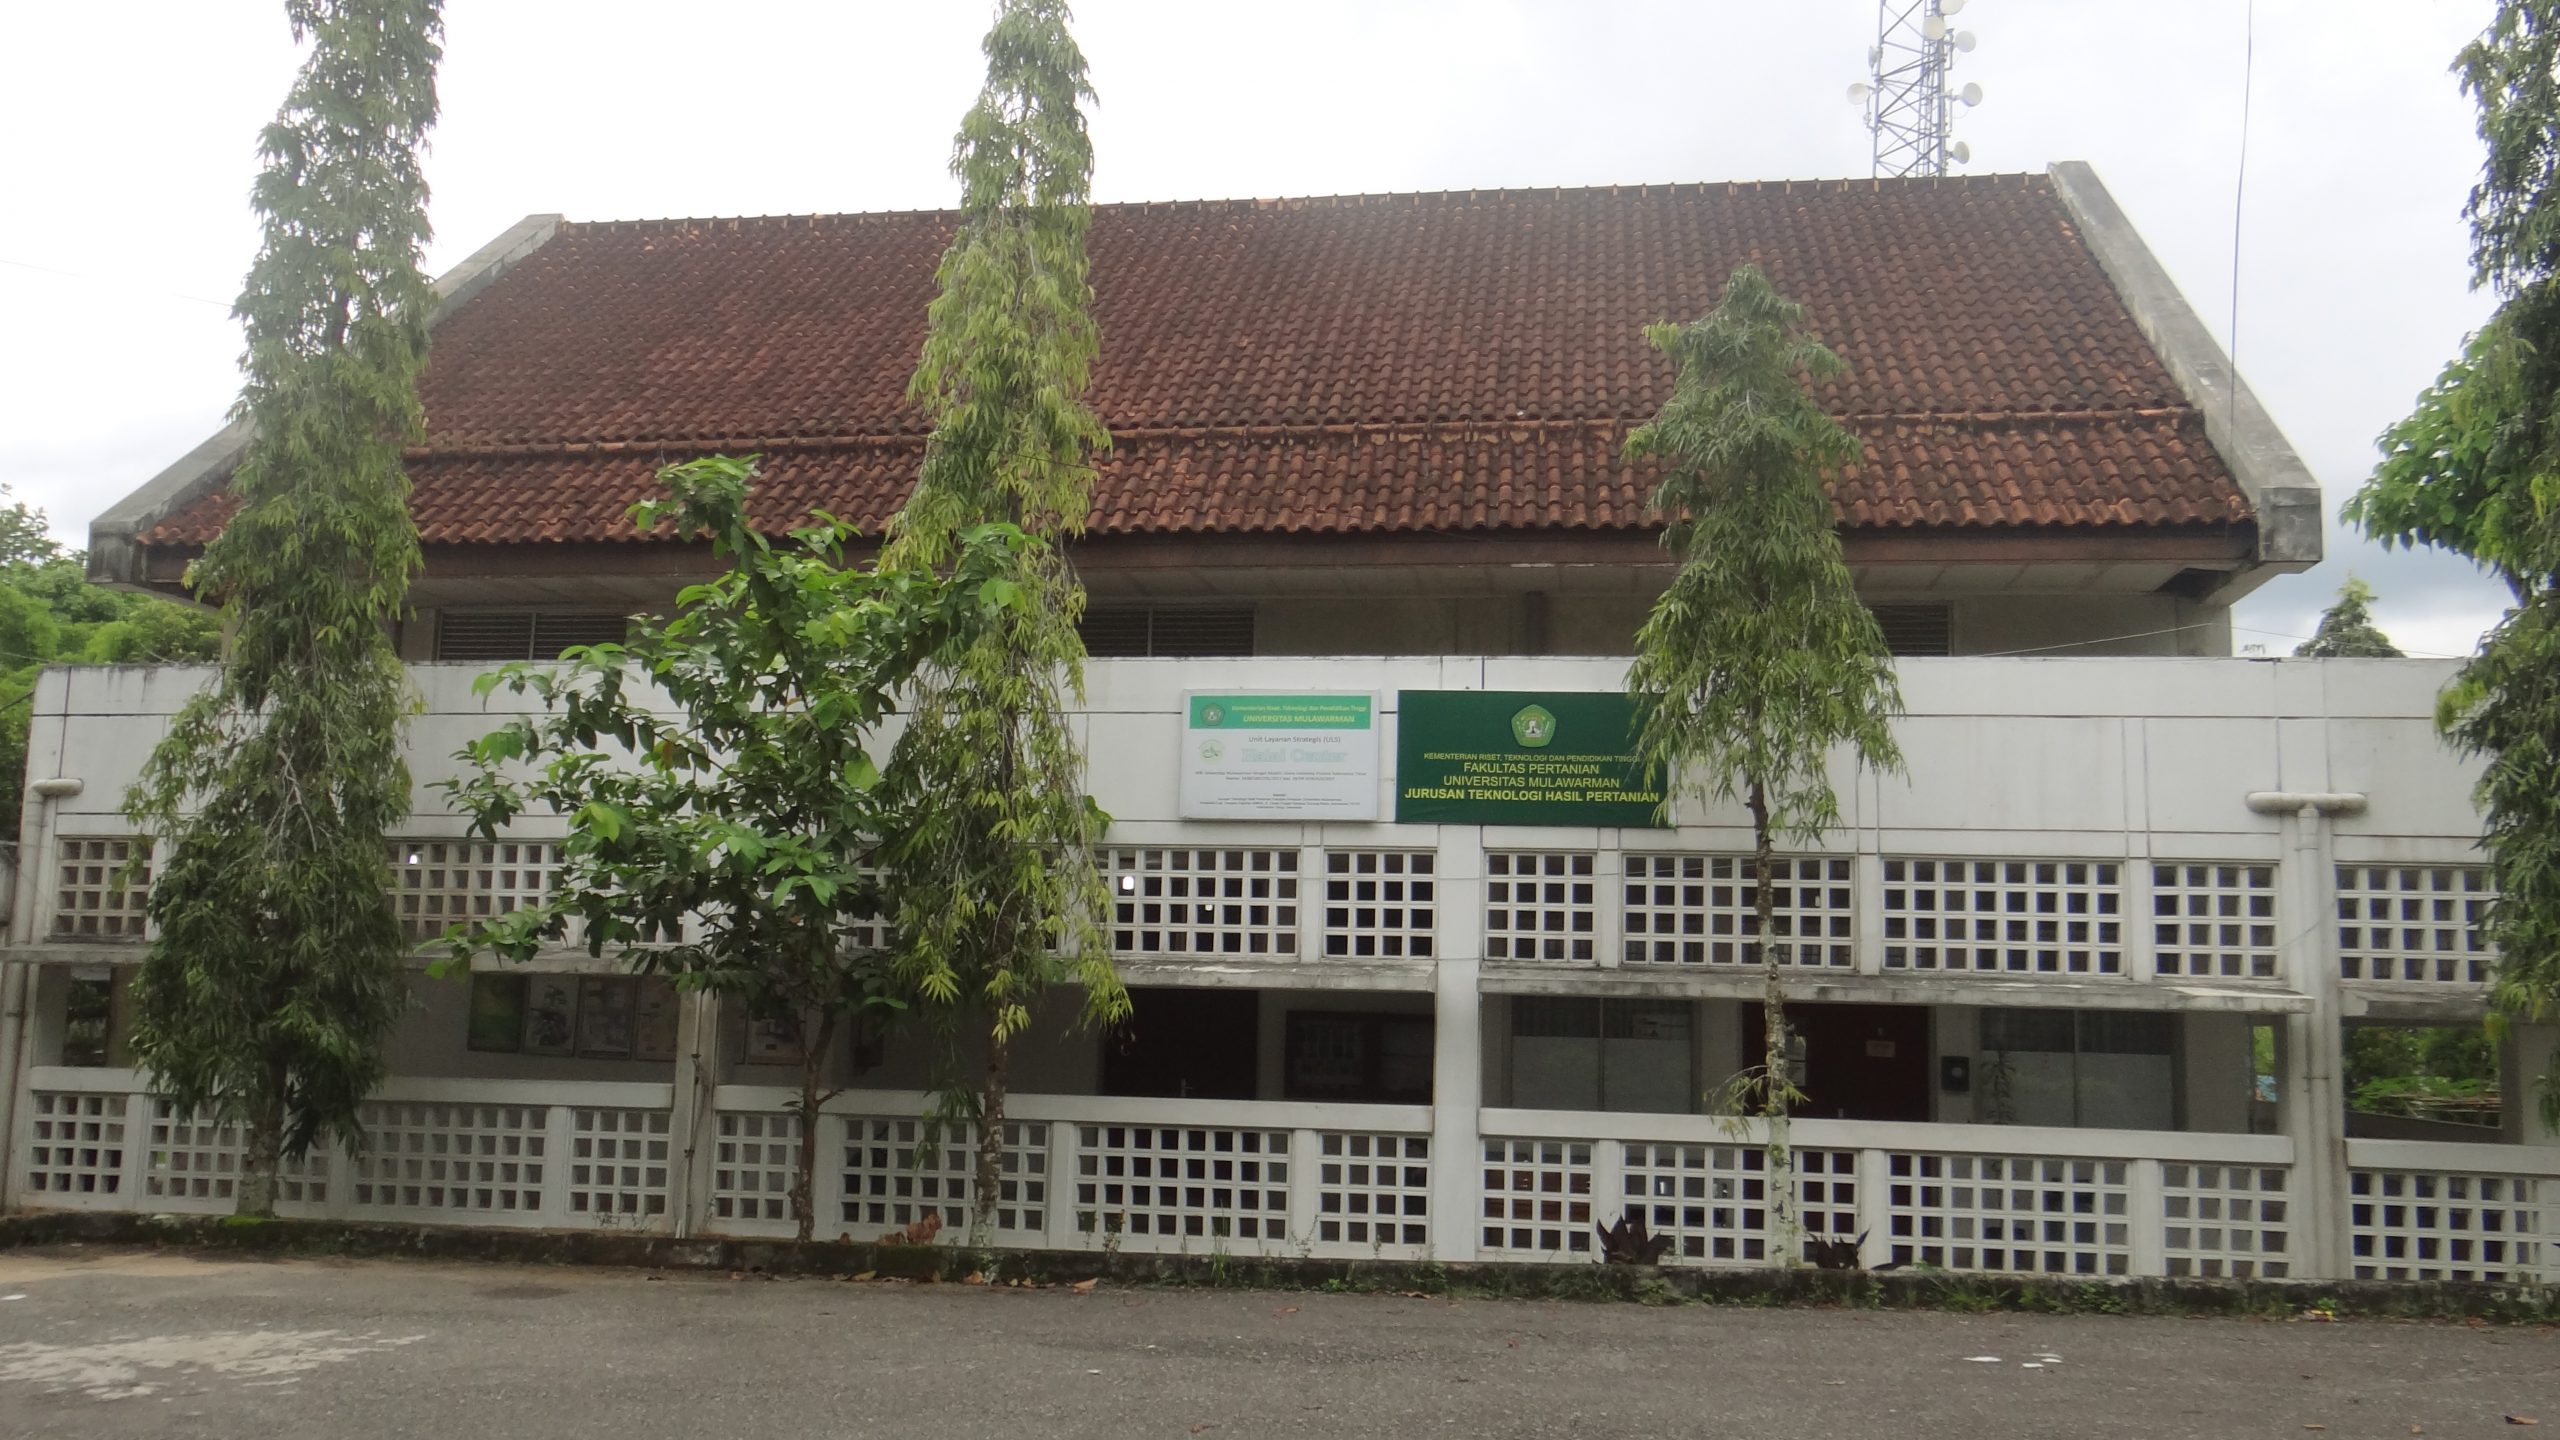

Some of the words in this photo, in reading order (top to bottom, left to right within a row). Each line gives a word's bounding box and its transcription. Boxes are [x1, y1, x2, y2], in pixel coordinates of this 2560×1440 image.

[1243, 714, 1292, 722] UNIVERSITAS
[1294, 714, 1355, 723] MULAWARMAN
[1264, 736, 1291, 745] Layanan
[1293, 736, 1322, 745] Strategis
[1323, 736, 1341, 744] (ULS)
[1479, 753, 1502, 761] RISET,
[1464, 762, 1525, 773] FAKULTAS
[1528, 763, 1599, 774] PERTANIAN
[1443, 775, 1525, 787] UNIVERSITAS
[1528, 777, 1620, 788] MULAWARMAN
[1404, 788, 1464, 799] JURUSAN
[1468, 789, 1542, 801] TEKNOLOGI
[1545, 791, 1583, 801] HASIL
[1586, 791, 1659, 802] PERTANIAN
